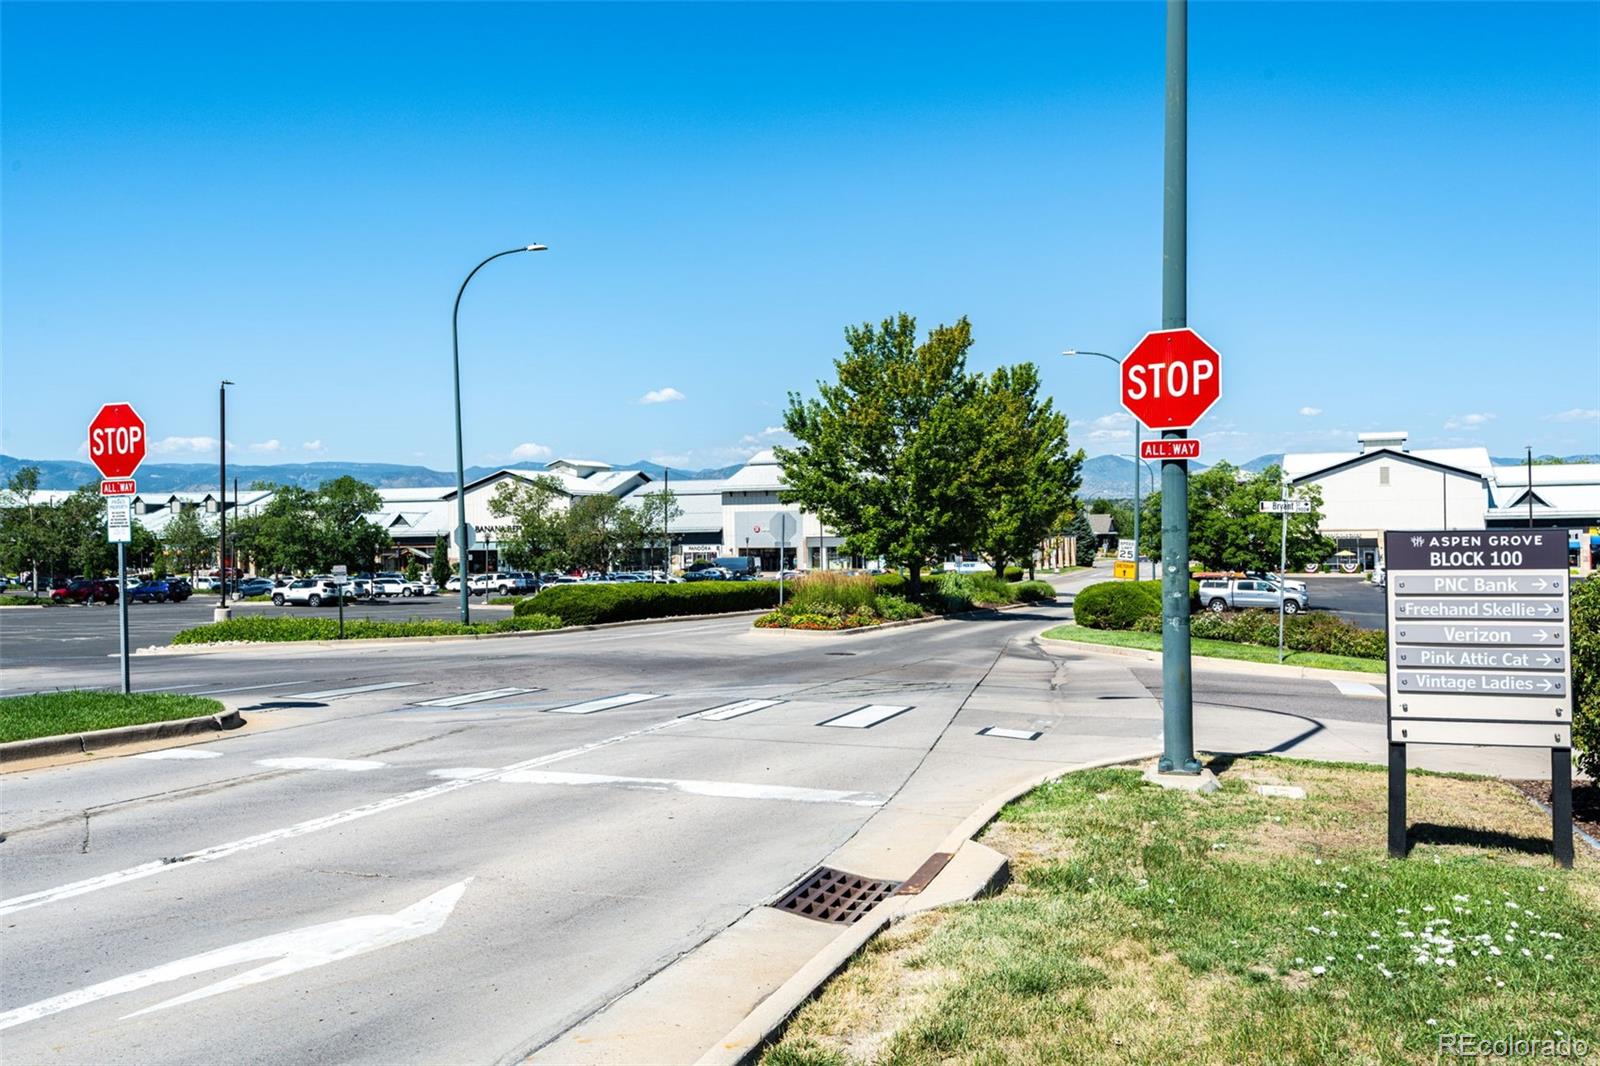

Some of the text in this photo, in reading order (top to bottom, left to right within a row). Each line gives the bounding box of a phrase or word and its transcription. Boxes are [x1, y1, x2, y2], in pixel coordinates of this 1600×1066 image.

[1127, 359, 1214, 400] STOP
[92, 426, 142, 456] STOP
[1145, 443, 1195, 456] ALL WAY
[103, 482, 134, 493] ALL WAY
[1272, 502, 1294, 510] Bryant
[475, 525, 505, 533] BANANA
[1429, 535, 1543, 547] ASPEN GROVE
[1119, 550, 1134, 559] 25
[1430, 551, 1523, 567] BLOCK 100
[1434, 577, 1518, 592] PNC Bank
[1405, 602, 1536, 616] Freehand Skellie
[1444, 627, 1512, 642] Verizon
[1421, 650, 1529, 666] Pink Attic Cat
[1416, 674, 1534, 692] Vintage Ladies
